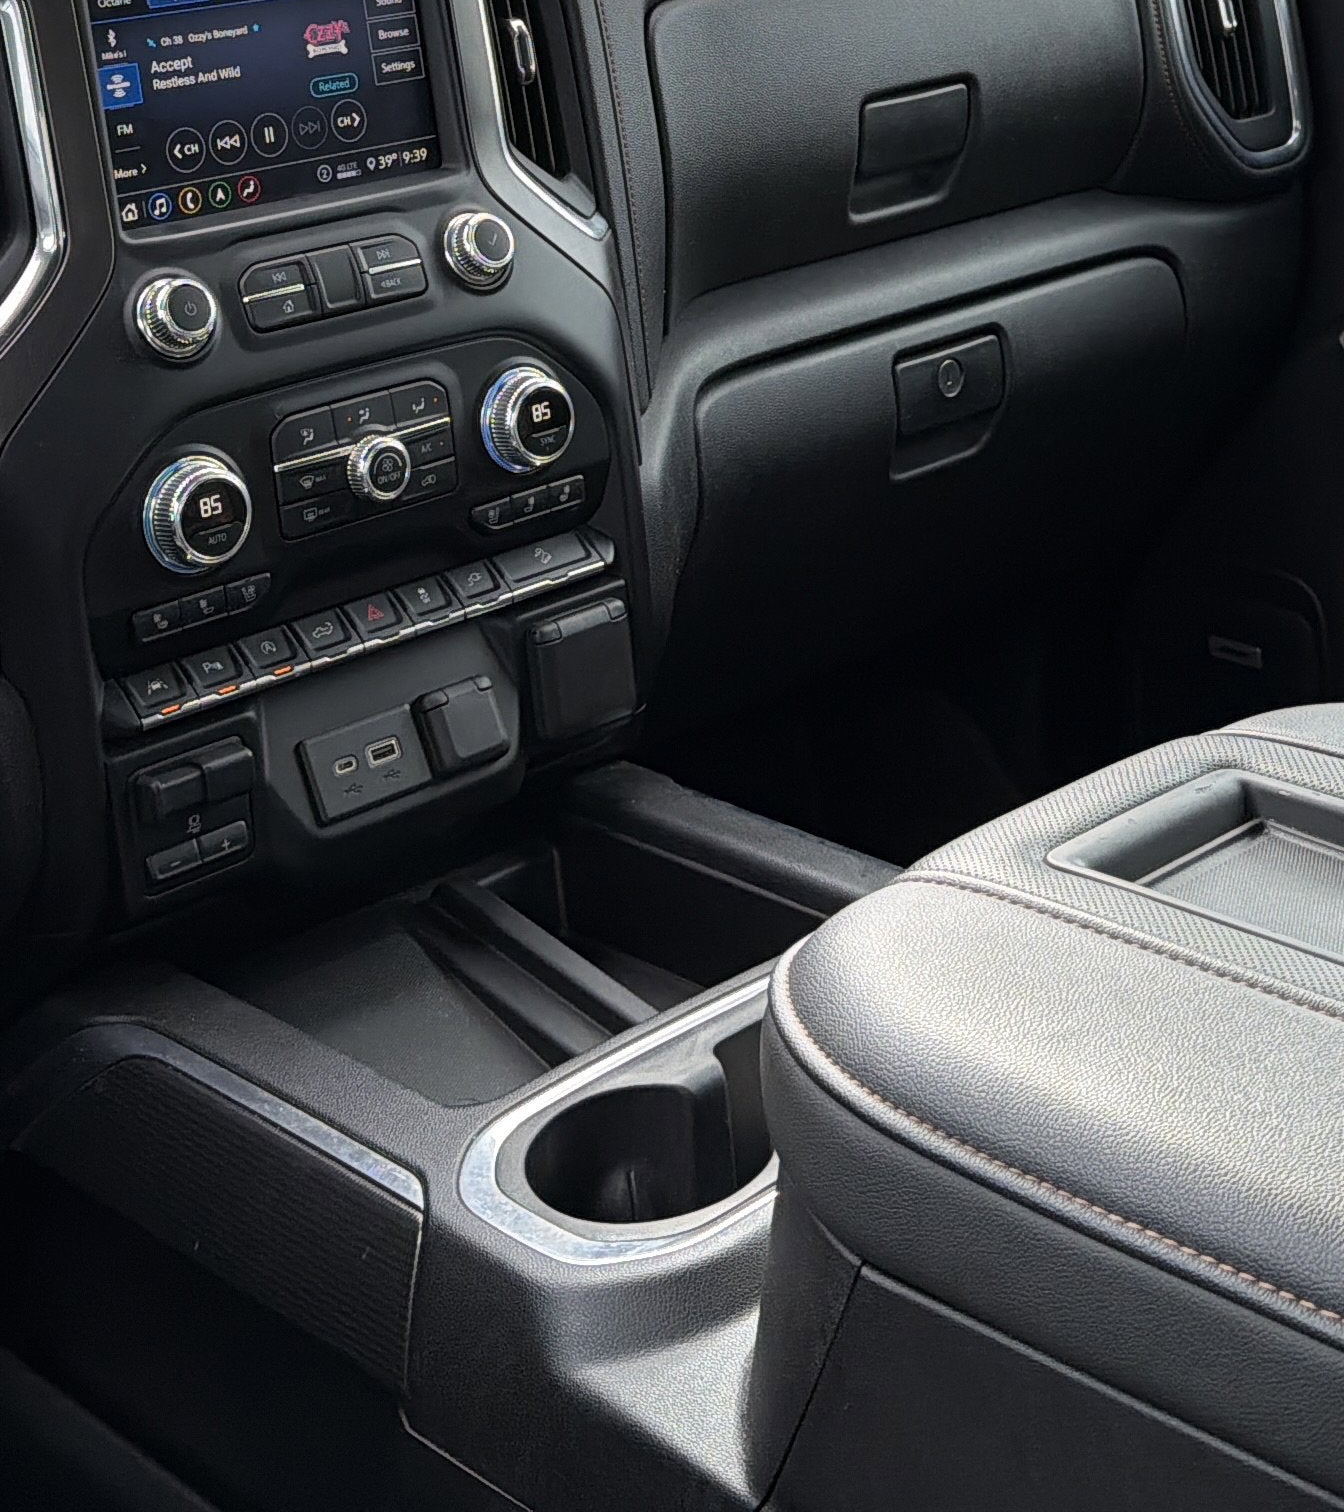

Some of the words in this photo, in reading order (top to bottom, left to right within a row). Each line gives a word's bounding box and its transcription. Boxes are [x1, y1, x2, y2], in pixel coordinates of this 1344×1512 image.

[160, 37, 172, 47] Ch
[172, 35, 184, 45] 38
[187, 30, 213, 43] Ozzy's
[213, 25, 249, 40] Boneyard
[378, 27, 410, 40] Browse
[151, 56, 194, 73] Accept
[381, 60, 416, 74] Settings
[152, 74, 196, 90] Restless
[197, 70, 218, 84] And
[218, 65, 242, 81] Wild
[318, 78, 351, 92] Related
[337, 116, 352, 128] CH
[116, 124, 134, 137] FM
[184, 143, 200, 155] CH
[402, 147, 428, 164] 9:39
[114, 167, 139, 180] More
[531, 401, 552, 423] 85
[377, 470, 402, 485] ON/OFF
[199, 494, 223, 519] 85
[208, 532, 227, 545] AUTO
